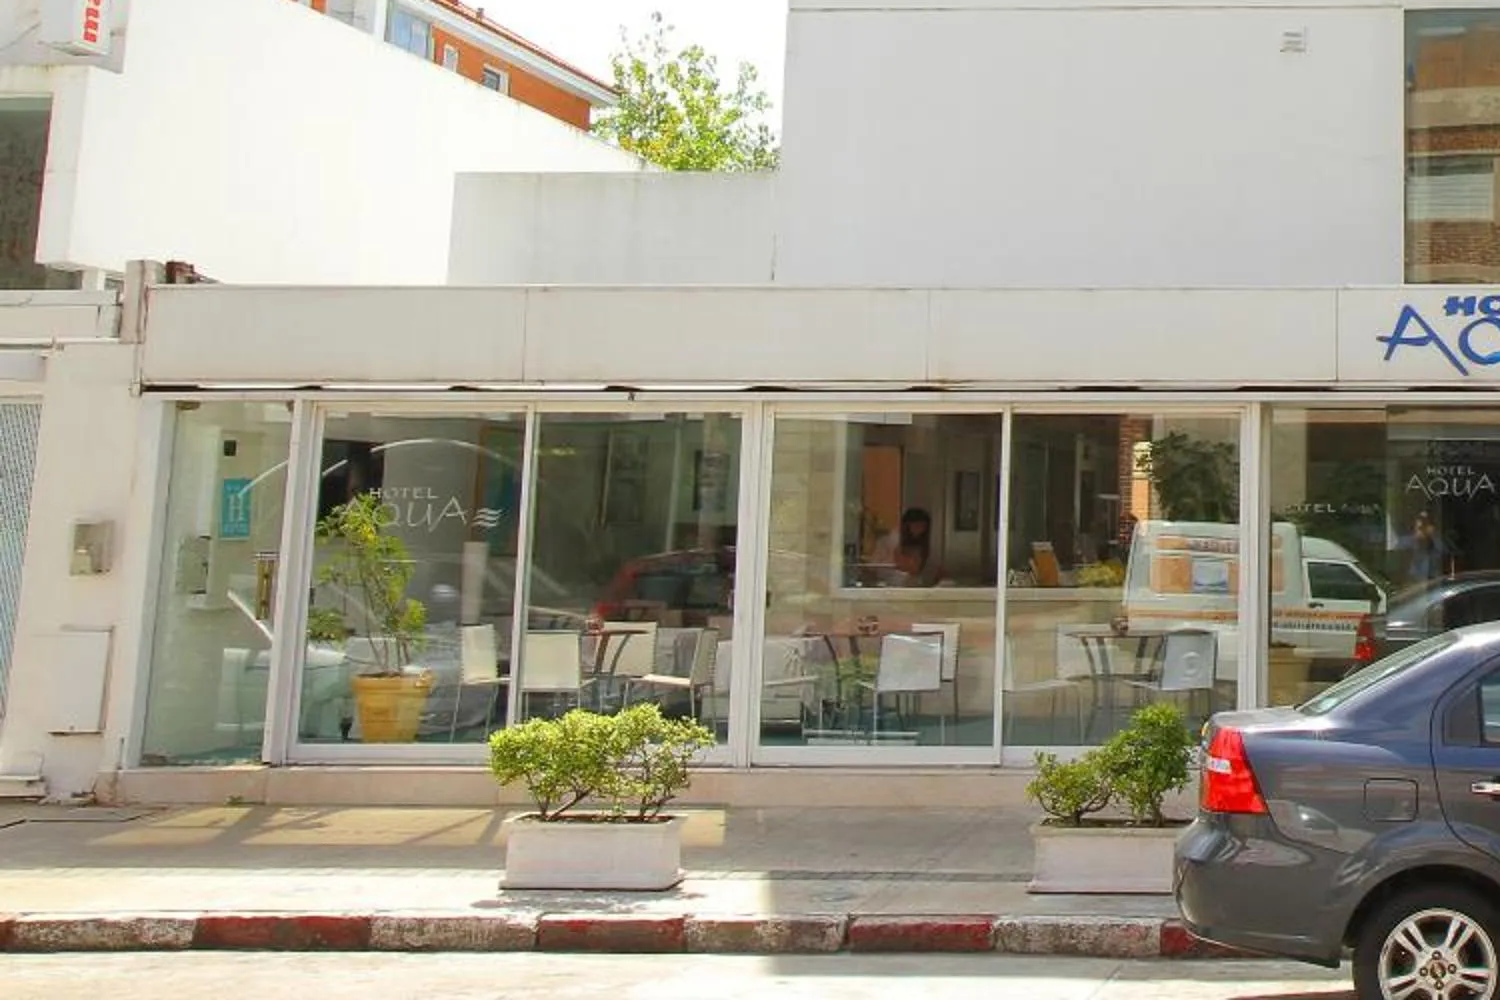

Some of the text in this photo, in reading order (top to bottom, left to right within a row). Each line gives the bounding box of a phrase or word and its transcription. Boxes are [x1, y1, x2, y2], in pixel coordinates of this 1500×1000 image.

[1426, 465, 1475, 476] HOTEL
[369, 486, 440, 499] HOTEL
[1405, 472, 1496, 501] AQUA
[341, 496, 470, 533] AQUA
